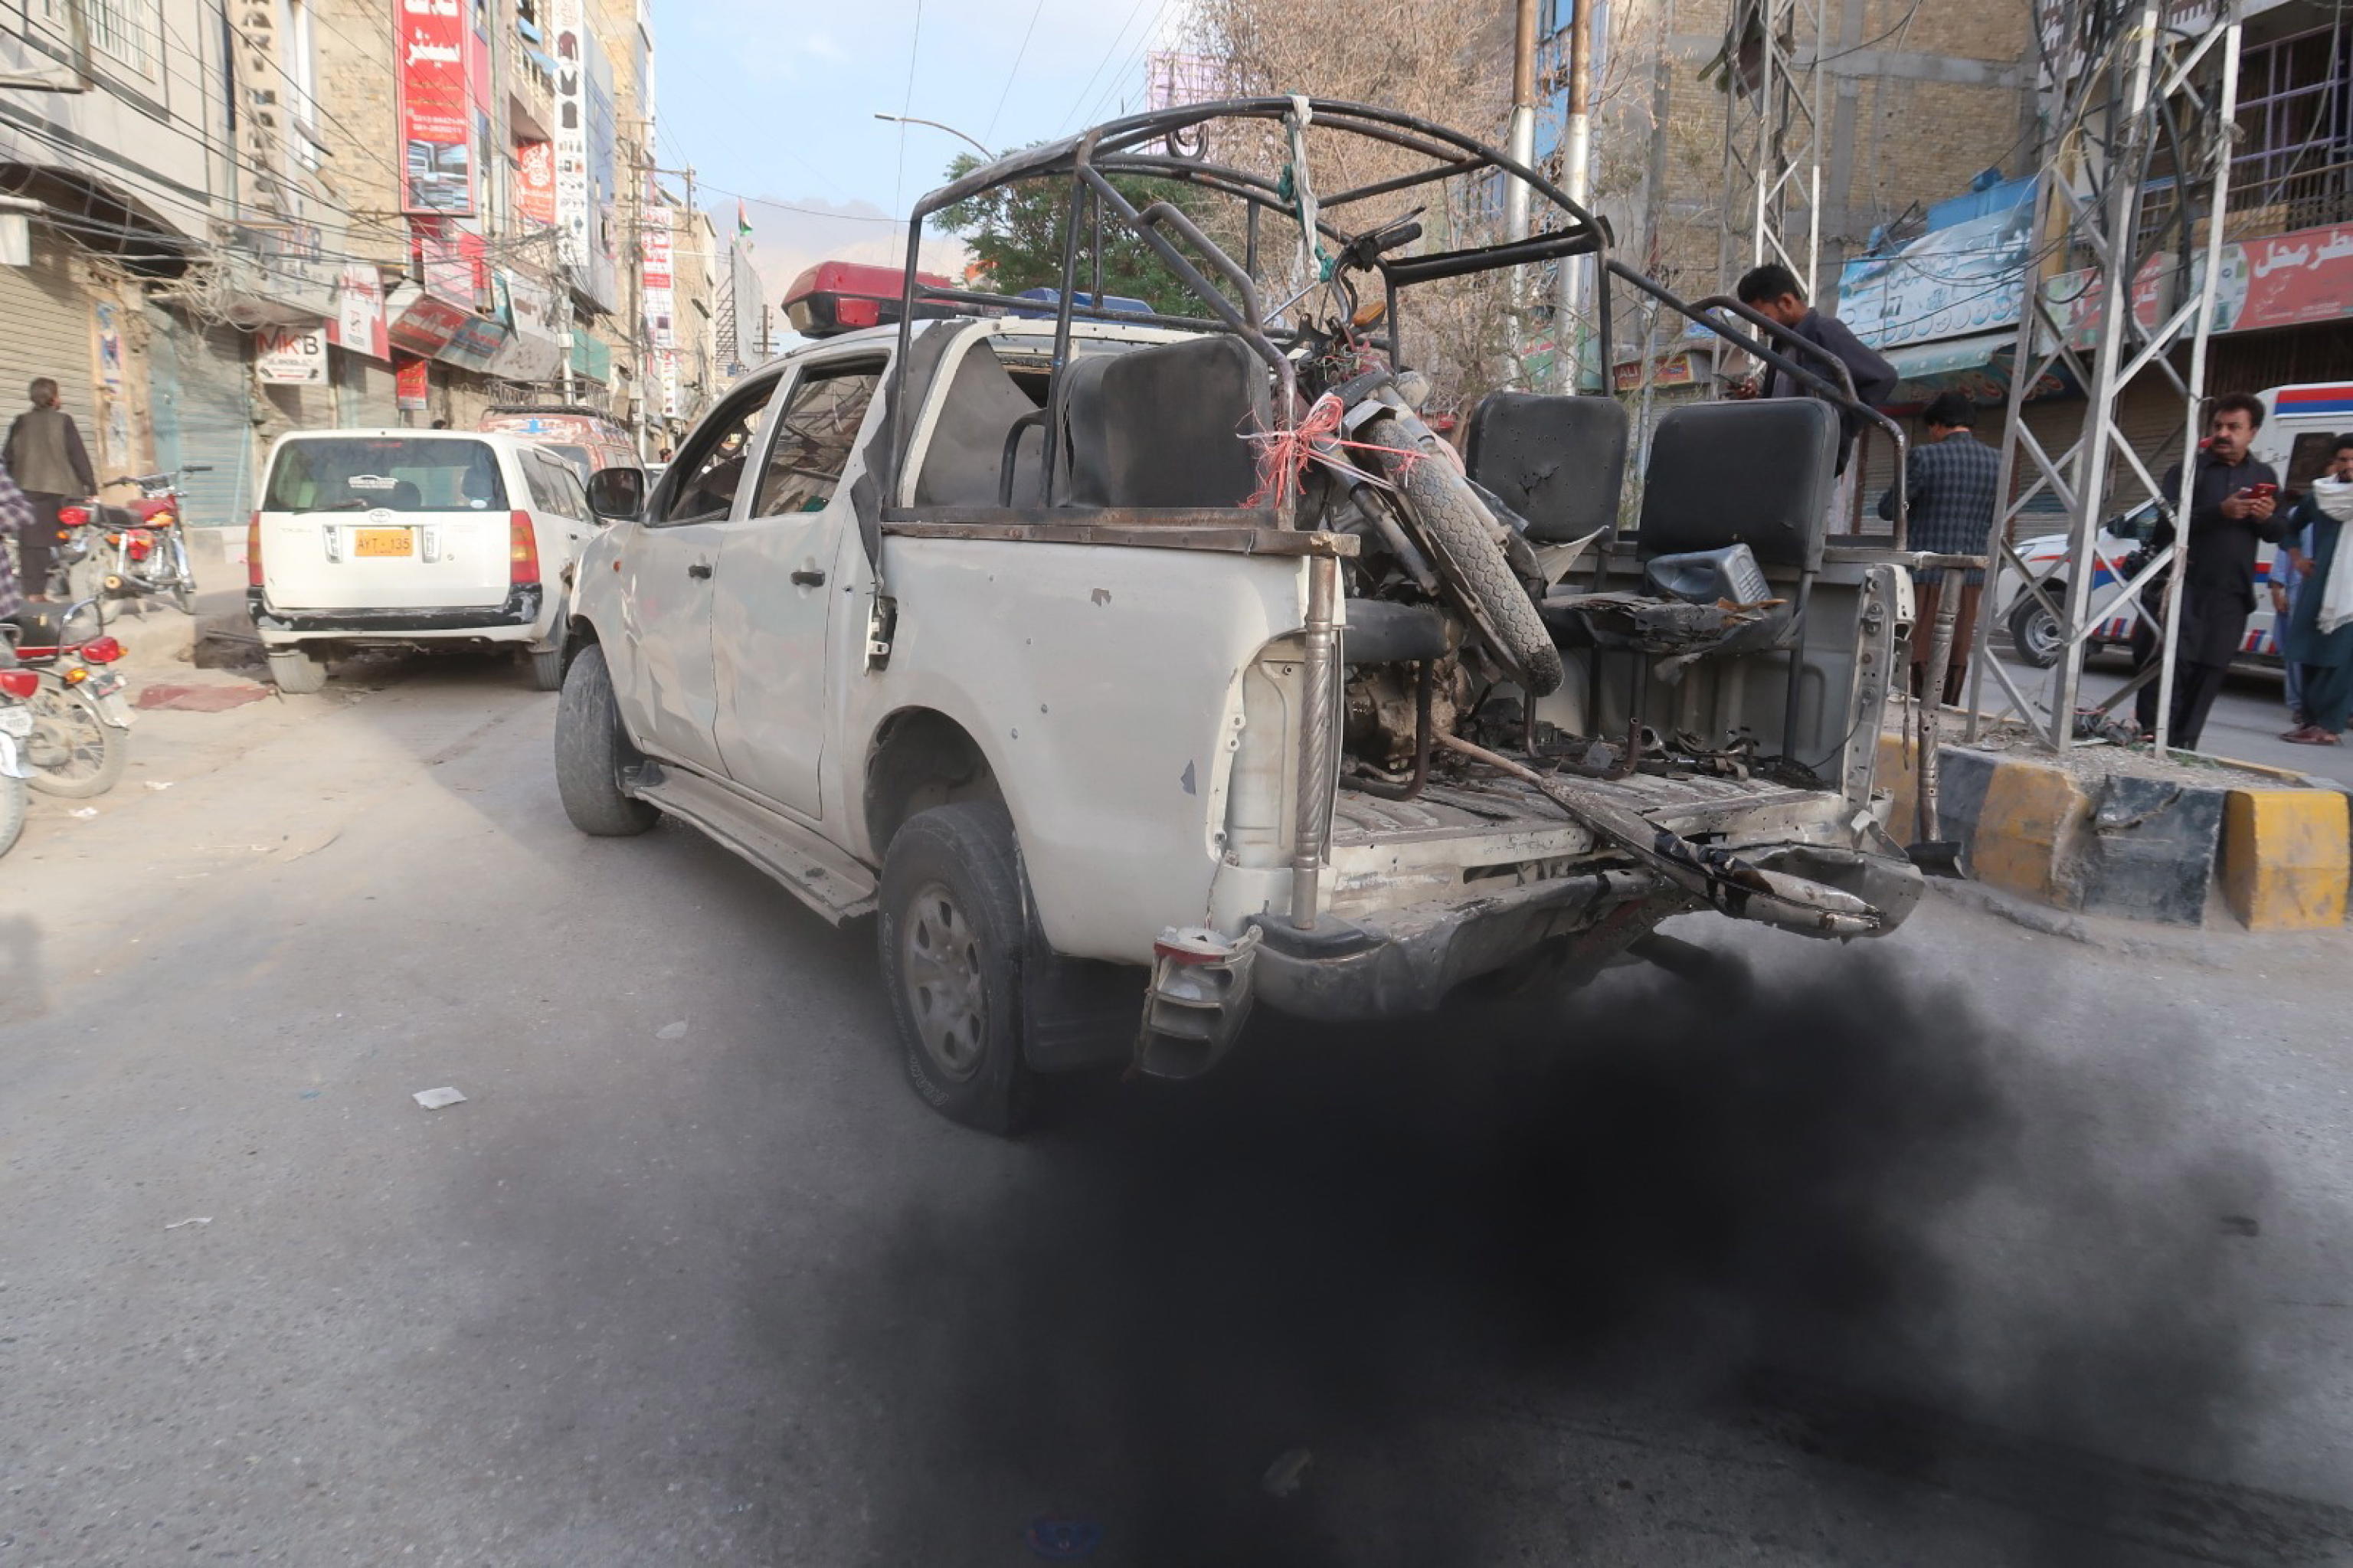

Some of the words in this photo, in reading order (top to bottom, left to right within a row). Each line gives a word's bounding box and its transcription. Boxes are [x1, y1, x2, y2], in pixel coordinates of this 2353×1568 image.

[2253, 241, 2311, 278] محل
[256, 326, 319, 355] MKB
[358, 538, 378, 551] AYT
[391, 538, 411, 550] 135
